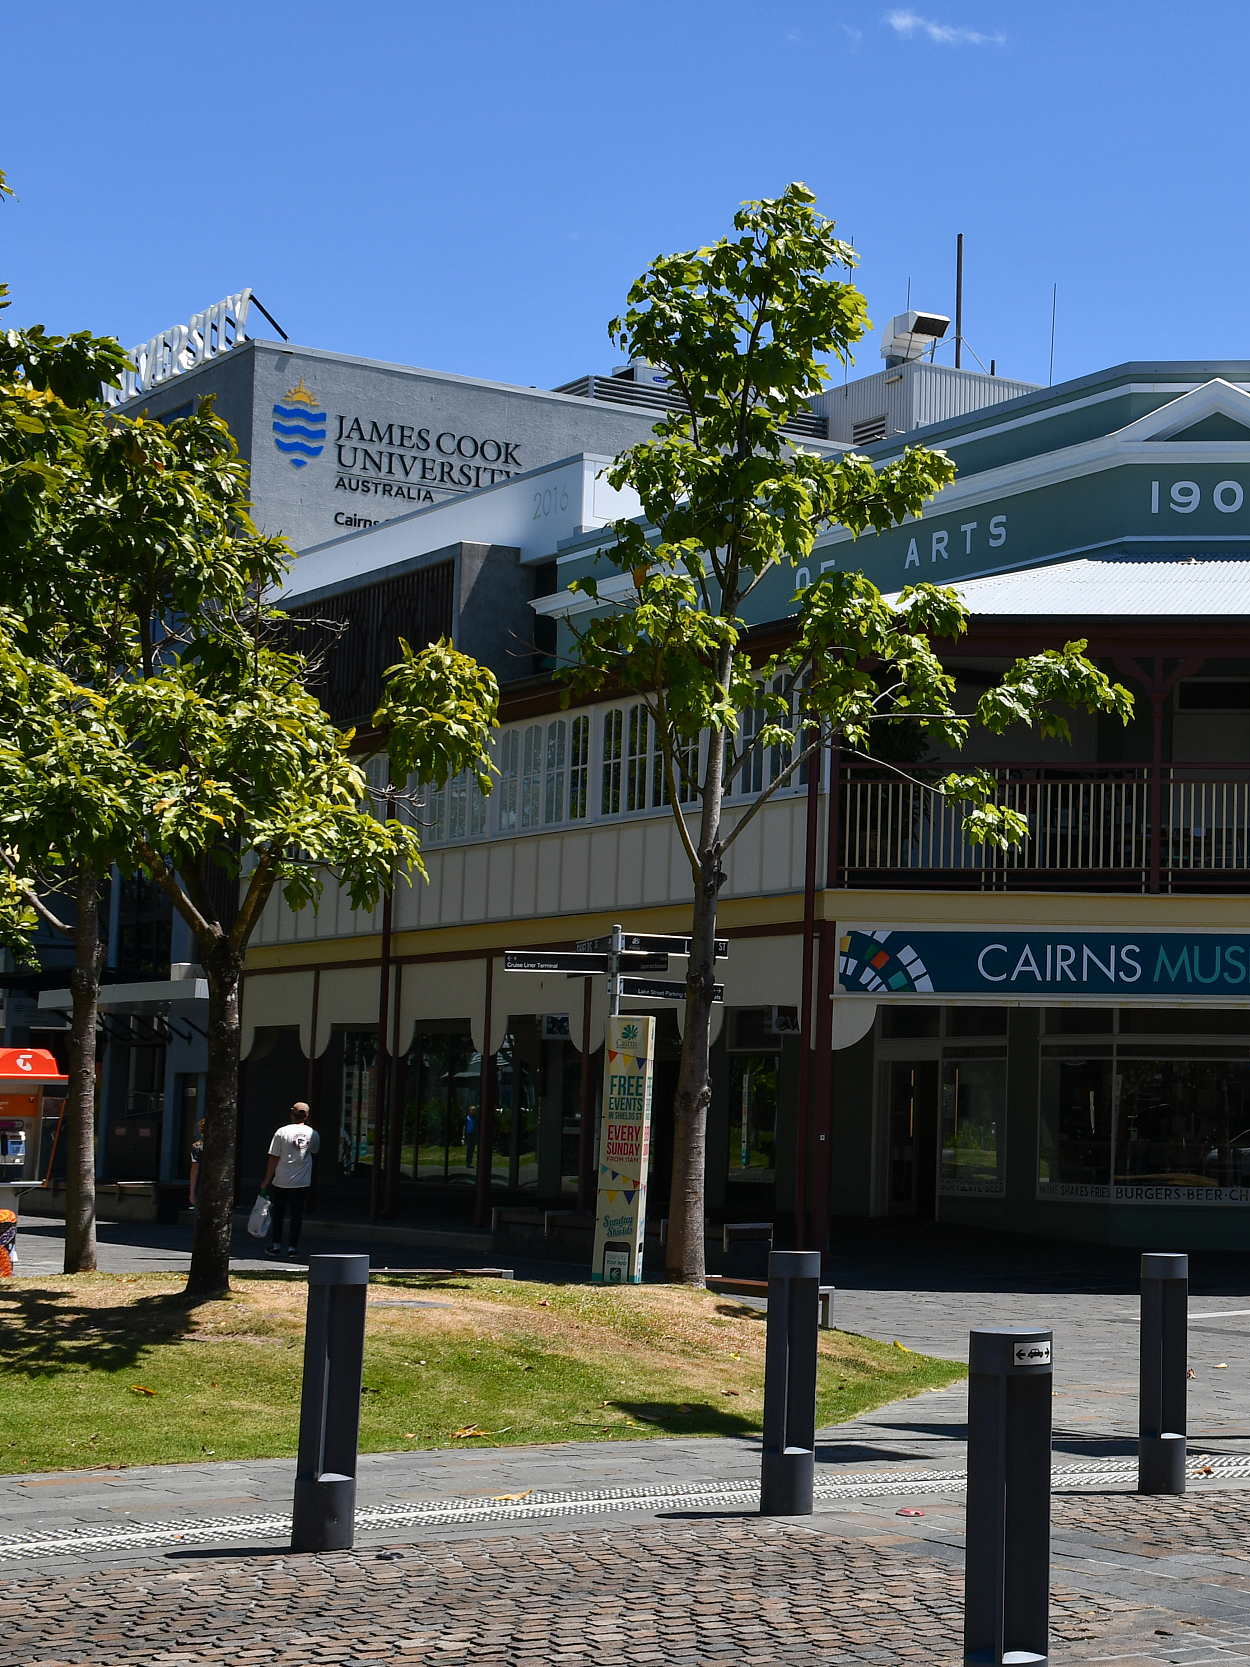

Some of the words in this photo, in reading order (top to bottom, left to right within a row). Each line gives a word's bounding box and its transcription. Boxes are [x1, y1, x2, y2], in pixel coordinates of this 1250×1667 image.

[335, 414, 431, 451] JAMES
[436, 432, 522, 466] COOK
[335, 443, 521, 489] UNIVERSIT
[335, 477, 434, 503] AUSTRALIA
[533, 483, 569, 521] 2016
[904, 514, 1007, 570] ARTS
[718, 942, 726, 951] ST
[977, 943, 1142, 983] CAIRNS
[665, 990, 683, 998] Parking
[616, 1039, 638, 1047] Cairns
[610, 1075, 644, 1096] FREE
[608, 1097, 643, 1112] EVENTS
[608, 1111, 614, 1120] IN
[615, 1112, 635, 1120] SHIELDS
[608, 1125, 641, 1141] EVERY
[606, 1142, 640, 1156] SUNDAY
[603, 1215, 633, 1228] Sunday
[607, 1226, 633, 1238] Shields
